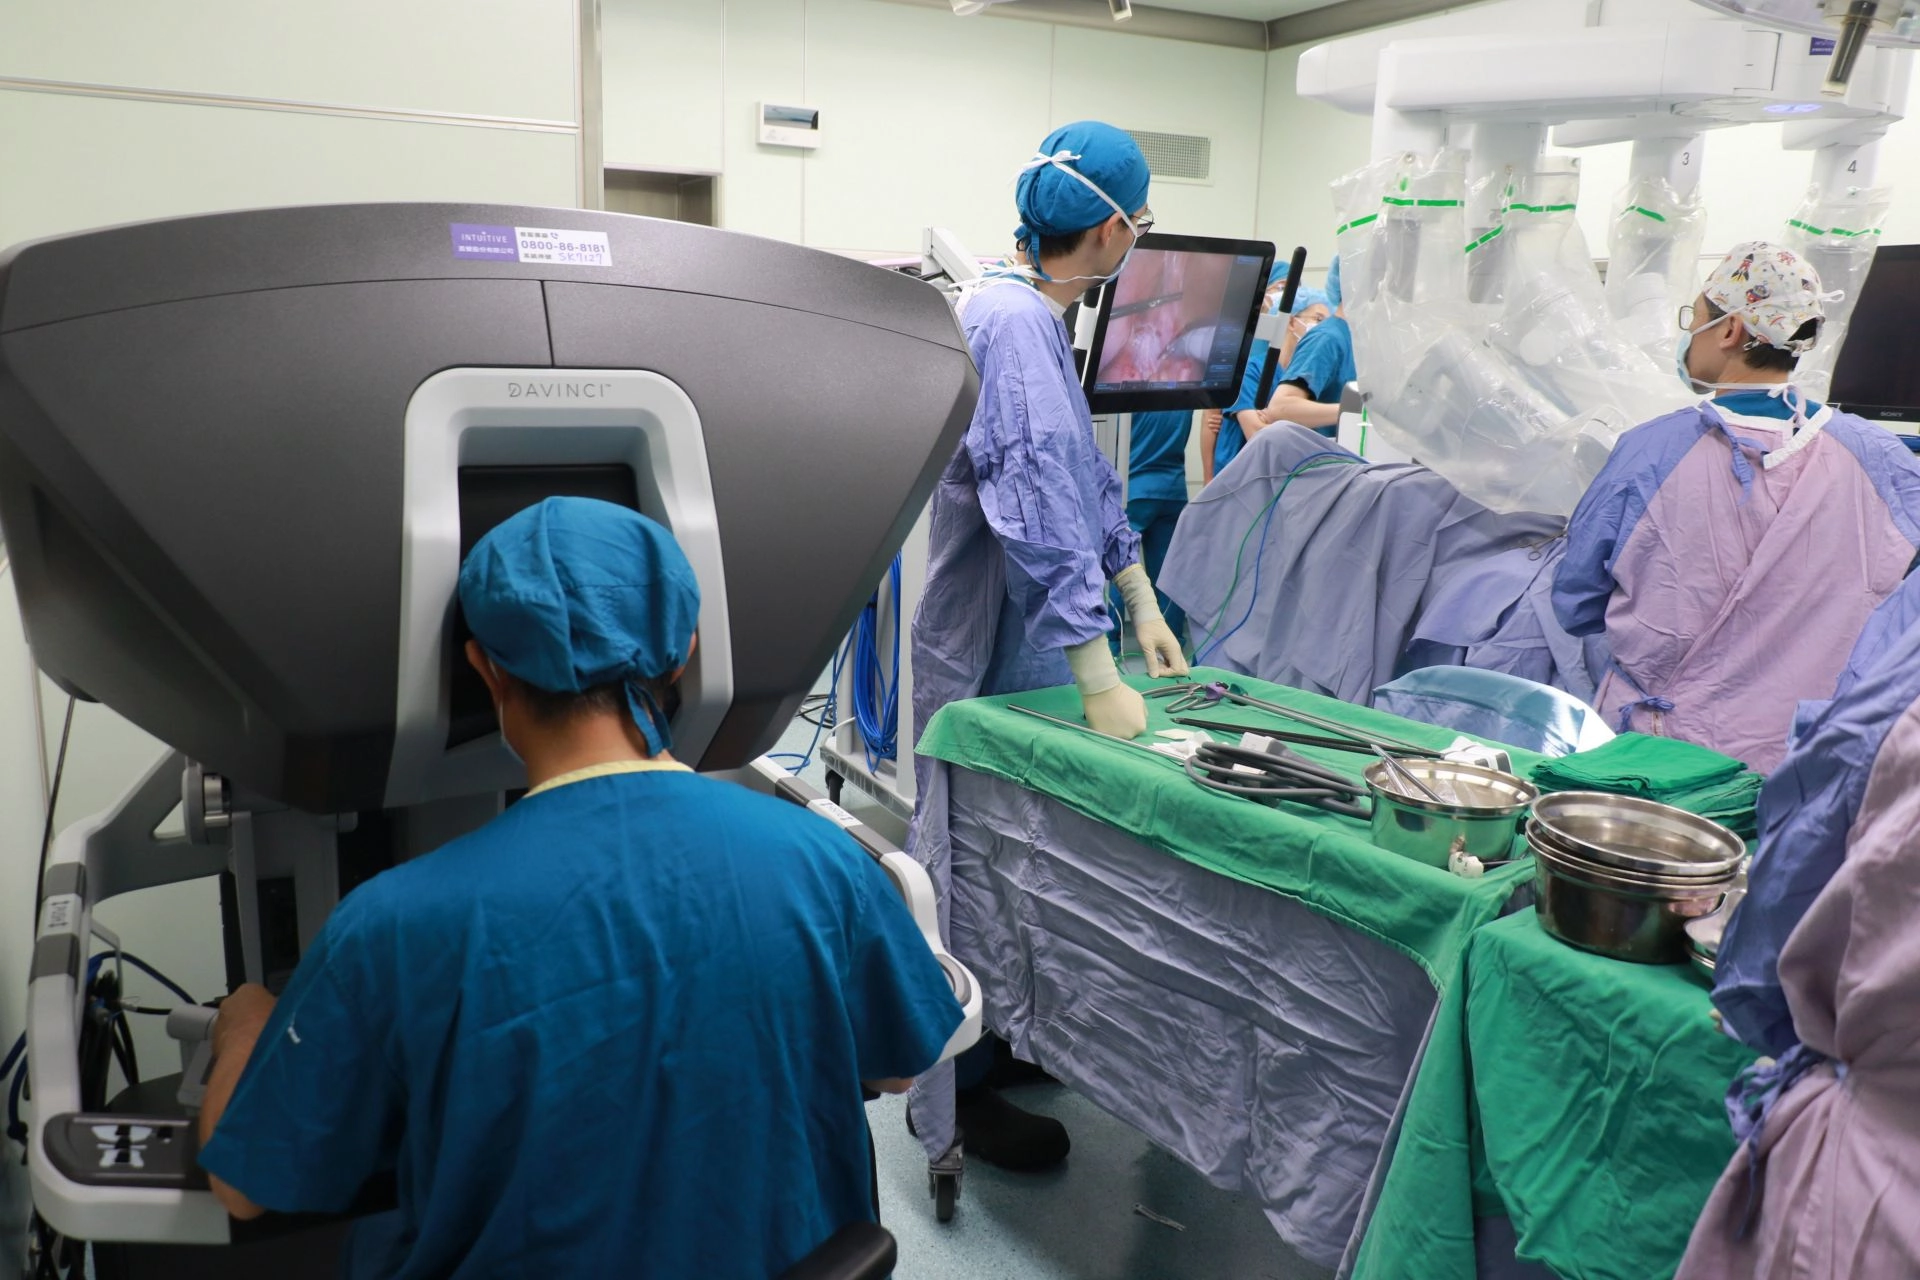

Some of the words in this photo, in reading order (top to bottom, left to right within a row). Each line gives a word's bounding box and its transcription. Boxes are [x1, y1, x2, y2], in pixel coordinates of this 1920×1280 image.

[1682, 152, 1690, 166] 3
[1847, 159, 1857, 174] 4
[461, 231, 508, 243] INTUITIVE
[521, 239, 606, 253] 0800-86-8181
